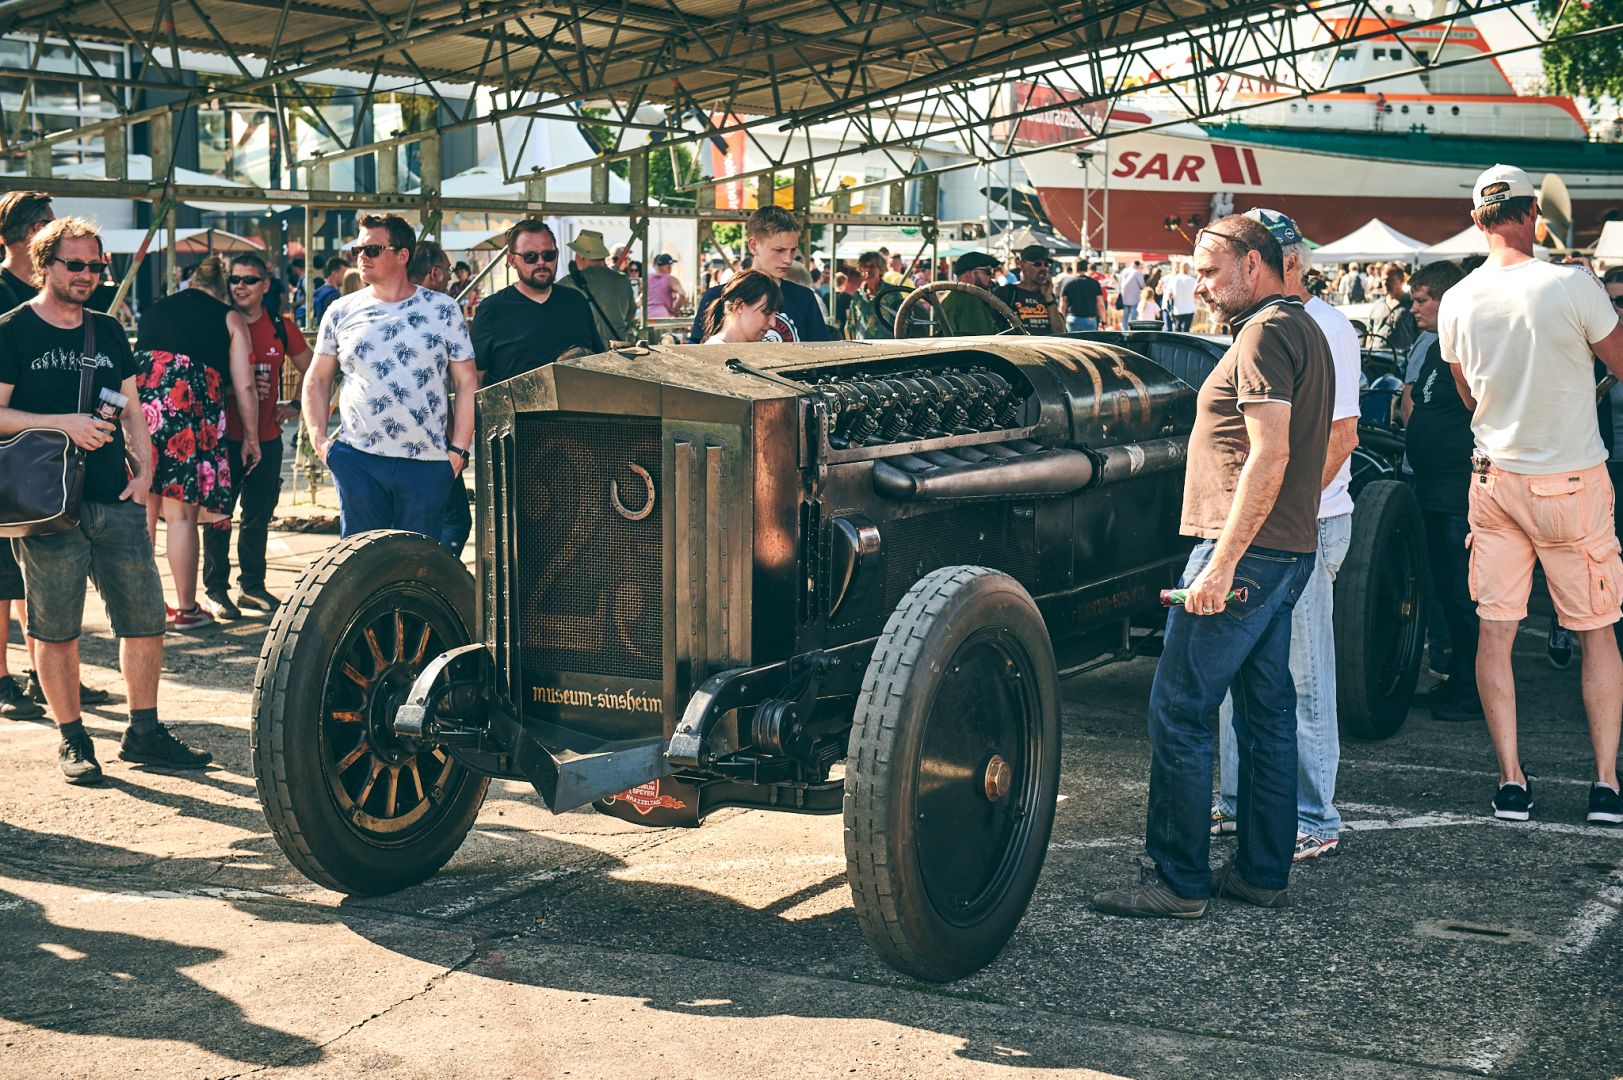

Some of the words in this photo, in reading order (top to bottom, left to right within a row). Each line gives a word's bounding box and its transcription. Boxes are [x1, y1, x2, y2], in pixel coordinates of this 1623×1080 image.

[1111, 151, 1206, 182] SAR
[532, 686, 663, 715] museum-sinsheim
[625, 794, 661, 806] BRAZZELTAG
[632, 788, 655, 797] SPEYER
